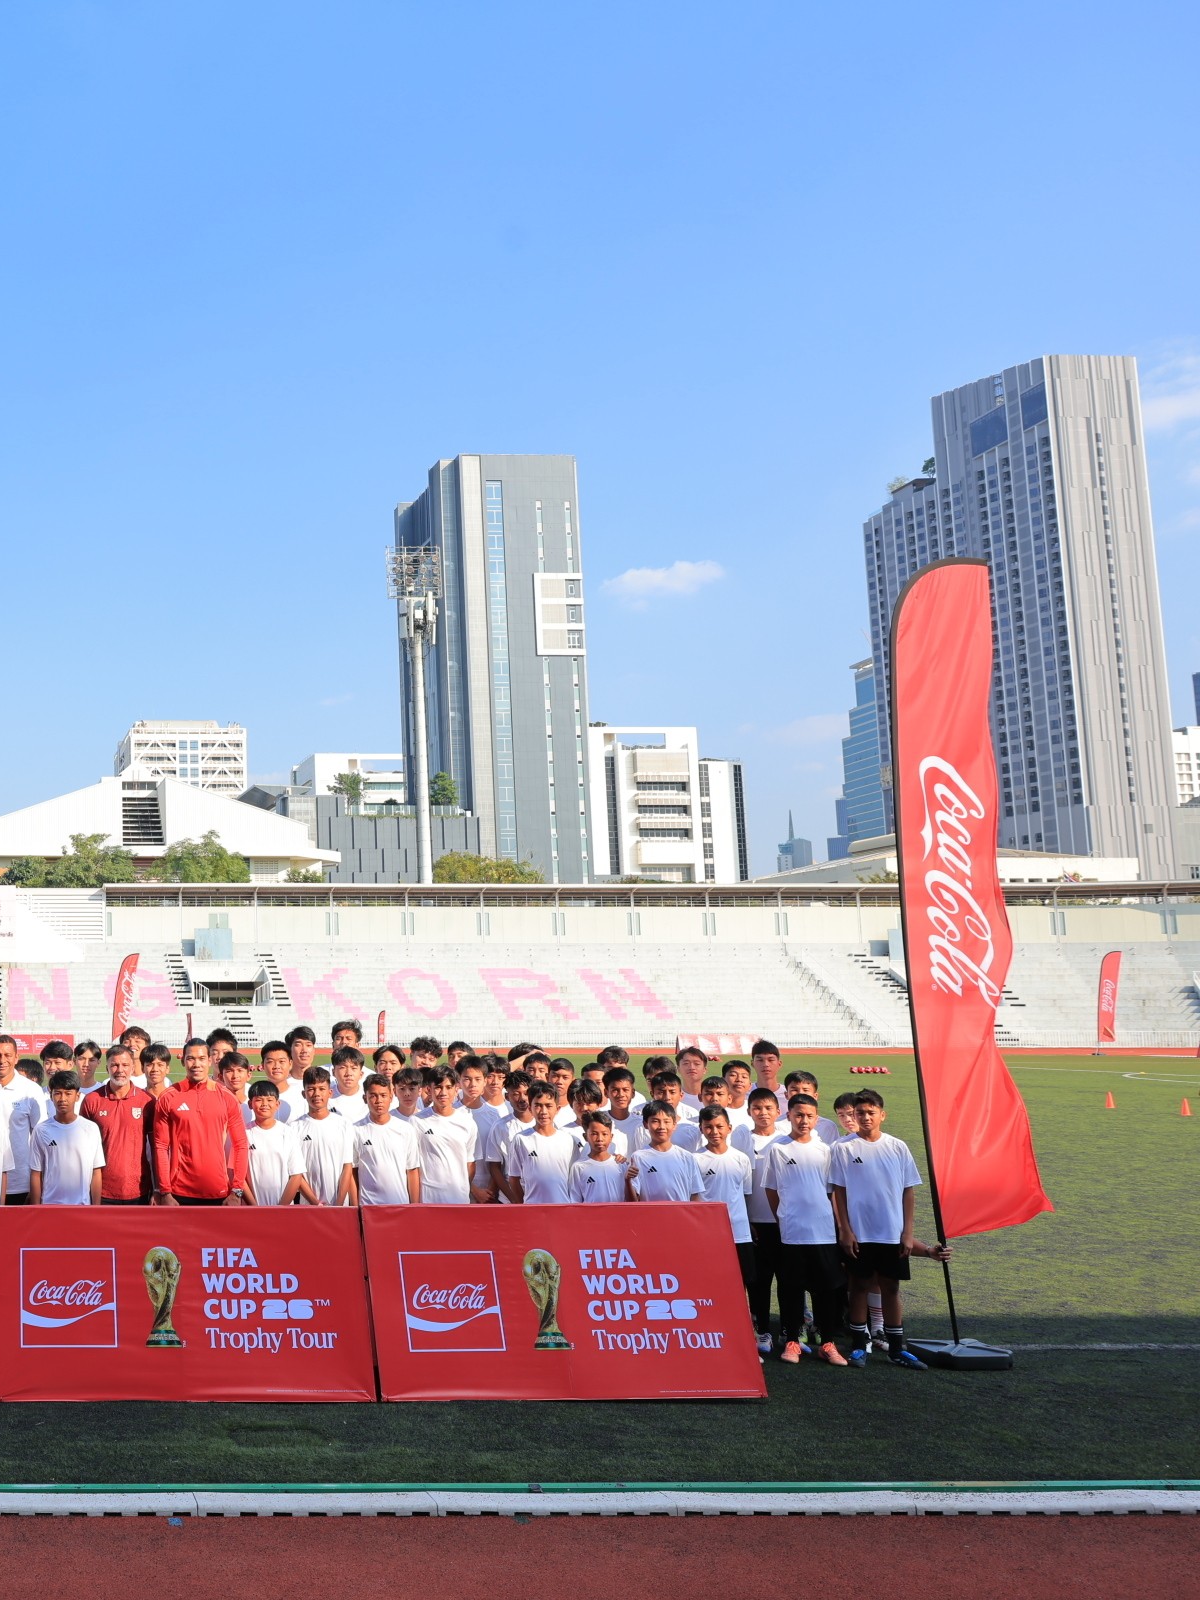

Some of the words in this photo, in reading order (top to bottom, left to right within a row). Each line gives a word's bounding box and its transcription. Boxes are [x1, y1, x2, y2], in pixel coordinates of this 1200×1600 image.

[919, 755, 1000, 1010] Coca-Cola
[201, 1247, 258, 1268] FIFA
[579, 1249, 637, 1270] FIFA
[29, 1279, 107, 1306] Coca-Cola
[201, 1273, 299, 1294] WORLD
[581, 1274, 679, 1295] WORLD
[413, 1283, 488, 1310] Coca-Cola
[203, 1299, 257, 1320] CUP
[587, 1300, 640, 1321] CUP
[205, 1326, 284, 1353] Trophy
[286, 1327, 338, 1349] Tour
[591, 1327, 670, 1355] Trophy
[672, 1328, 724, 1349] Tour
